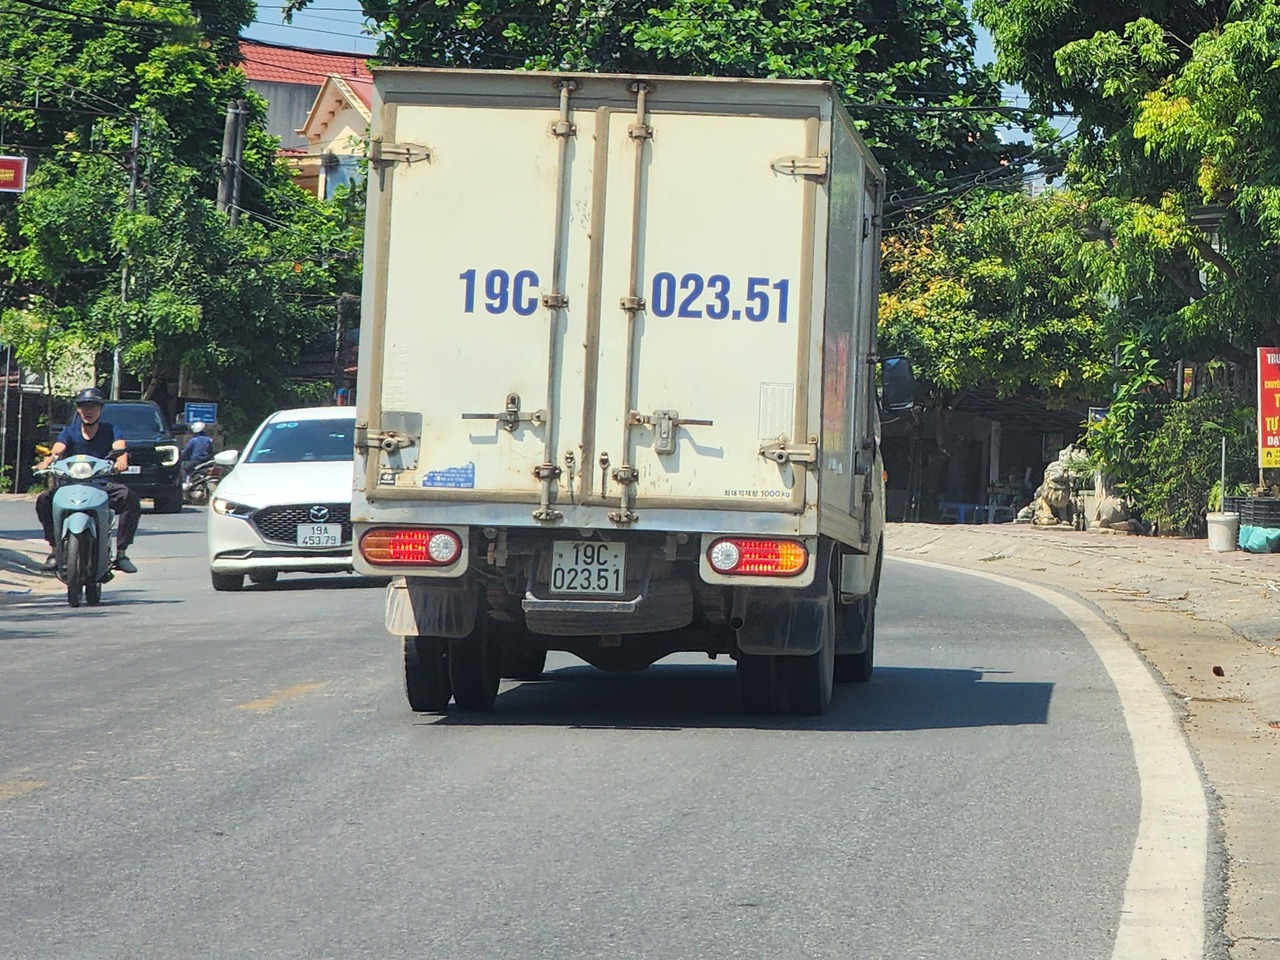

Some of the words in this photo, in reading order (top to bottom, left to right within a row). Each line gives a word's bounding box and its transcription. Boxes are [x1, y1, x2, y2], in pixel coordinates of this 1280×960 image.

[458, 269, 540, 316] 19C
[651, 271, 790, 323] 023.51
[303, 536, 336, 545] 453.79
[311, 526, 328, 535] 19A
[573, 545, 609, 567] 19C
[553, 568, 621, 591] 023.51
